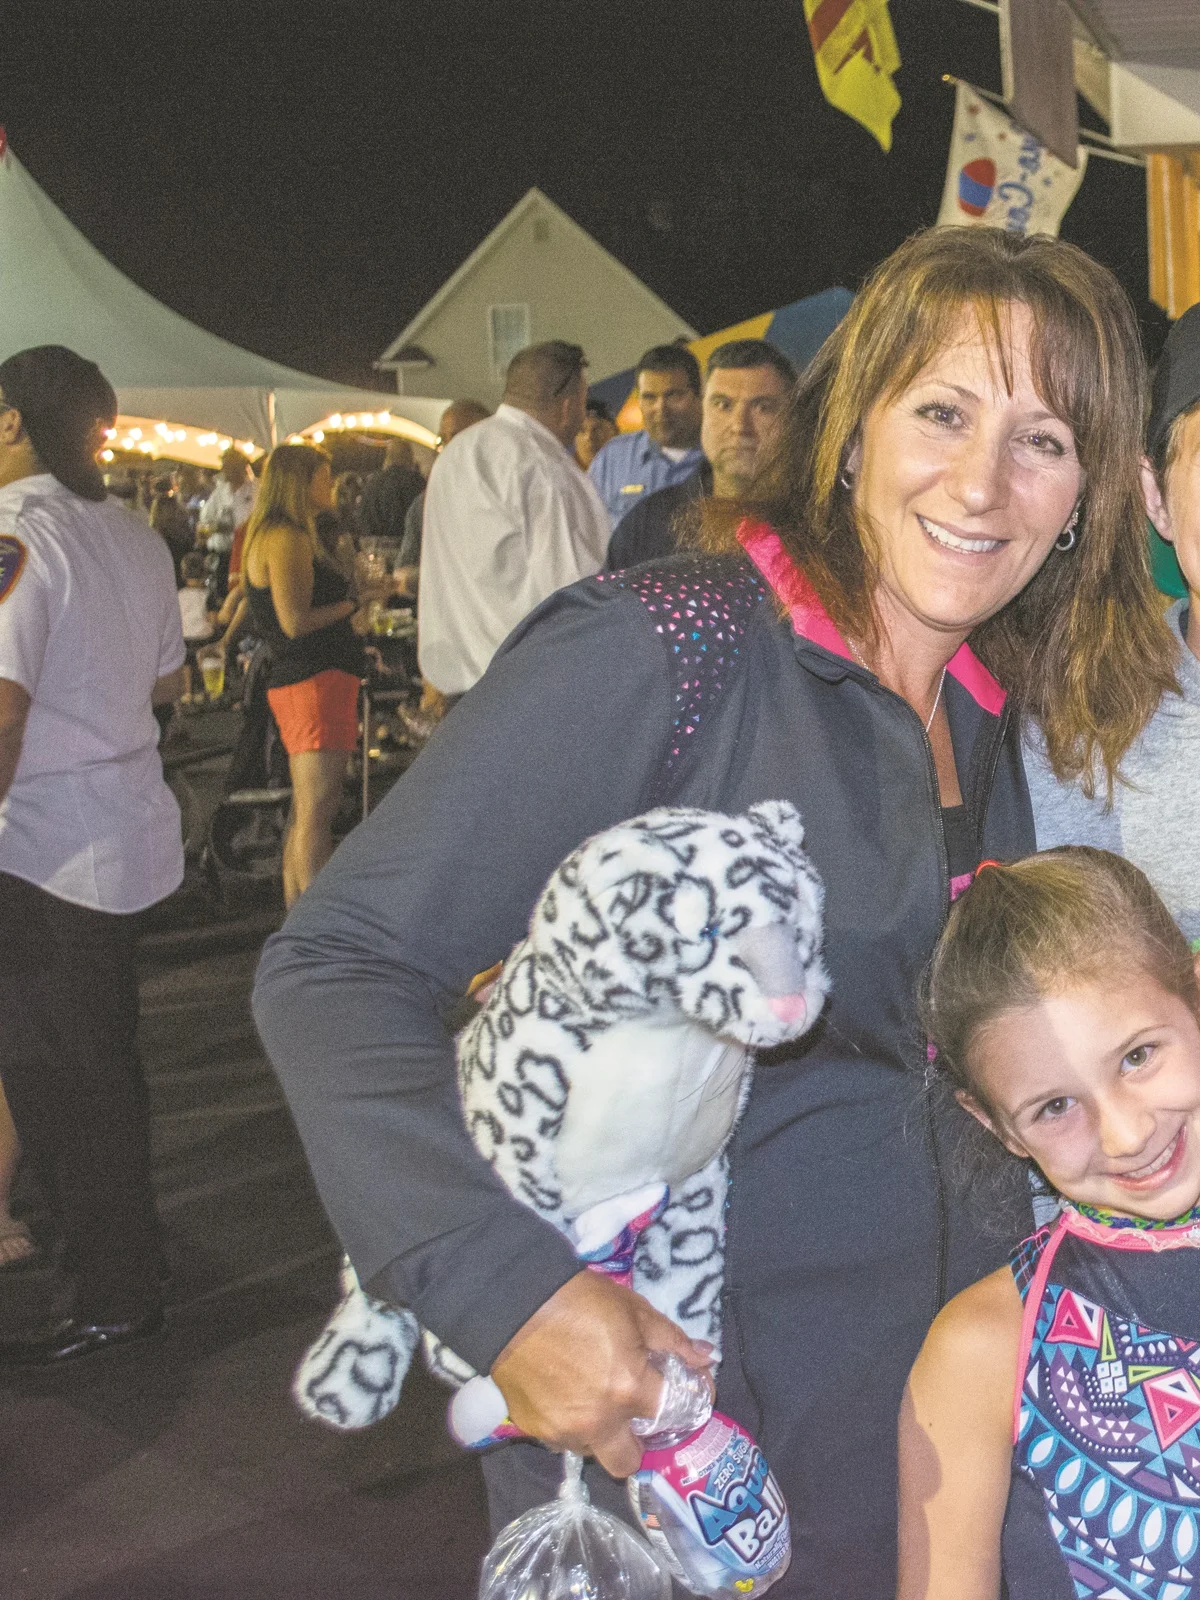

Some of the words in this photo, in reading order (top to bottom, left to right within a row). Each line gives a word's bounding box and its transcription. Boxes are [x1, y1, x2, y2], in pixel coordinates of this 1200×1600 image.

[691, 1450, 769, 1543] Aqua
[714, 1461, 736, 1492] ZERO
[723, 1472, 786, 1561] Ball
